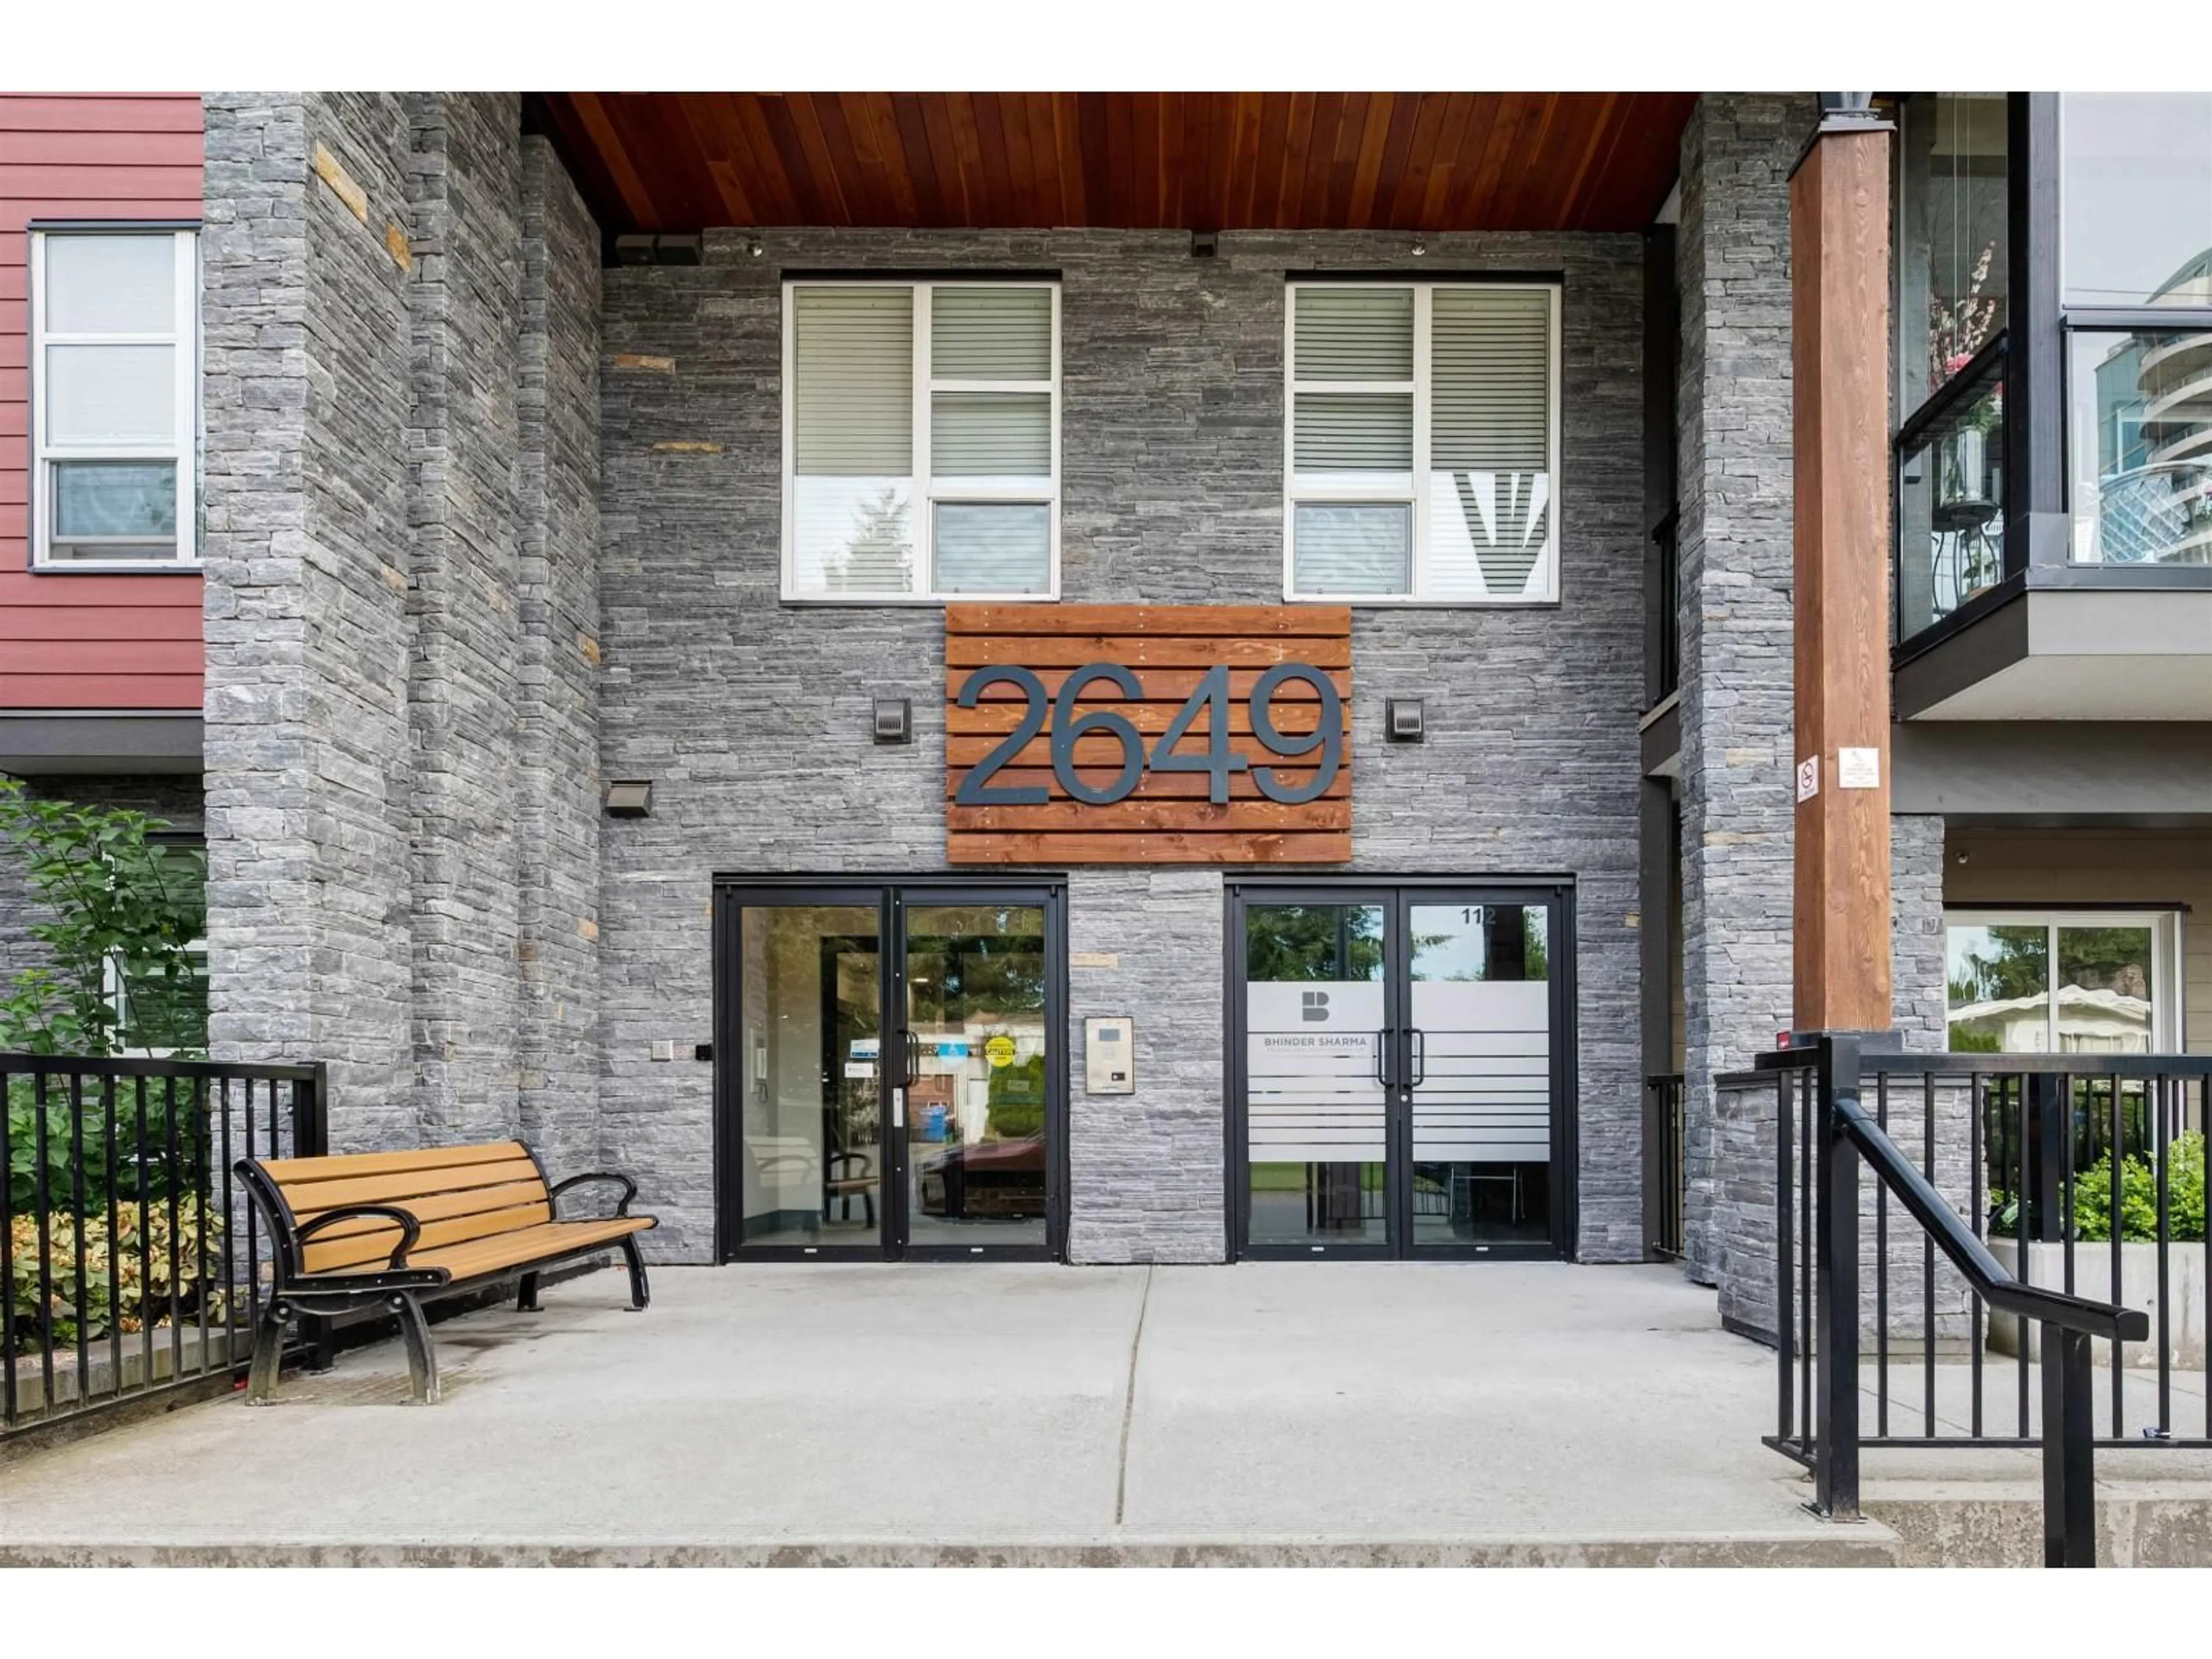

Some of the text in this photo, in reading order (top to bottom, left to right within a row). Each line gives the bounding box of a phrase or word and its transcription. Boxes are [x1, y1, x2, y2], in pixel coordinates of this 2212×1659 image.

[955, 663, 1343, 804] 2649
[1461, 907, 1497, 925] 112
[1264, 1037, 1366, 1046] BHINDER SHARMA
